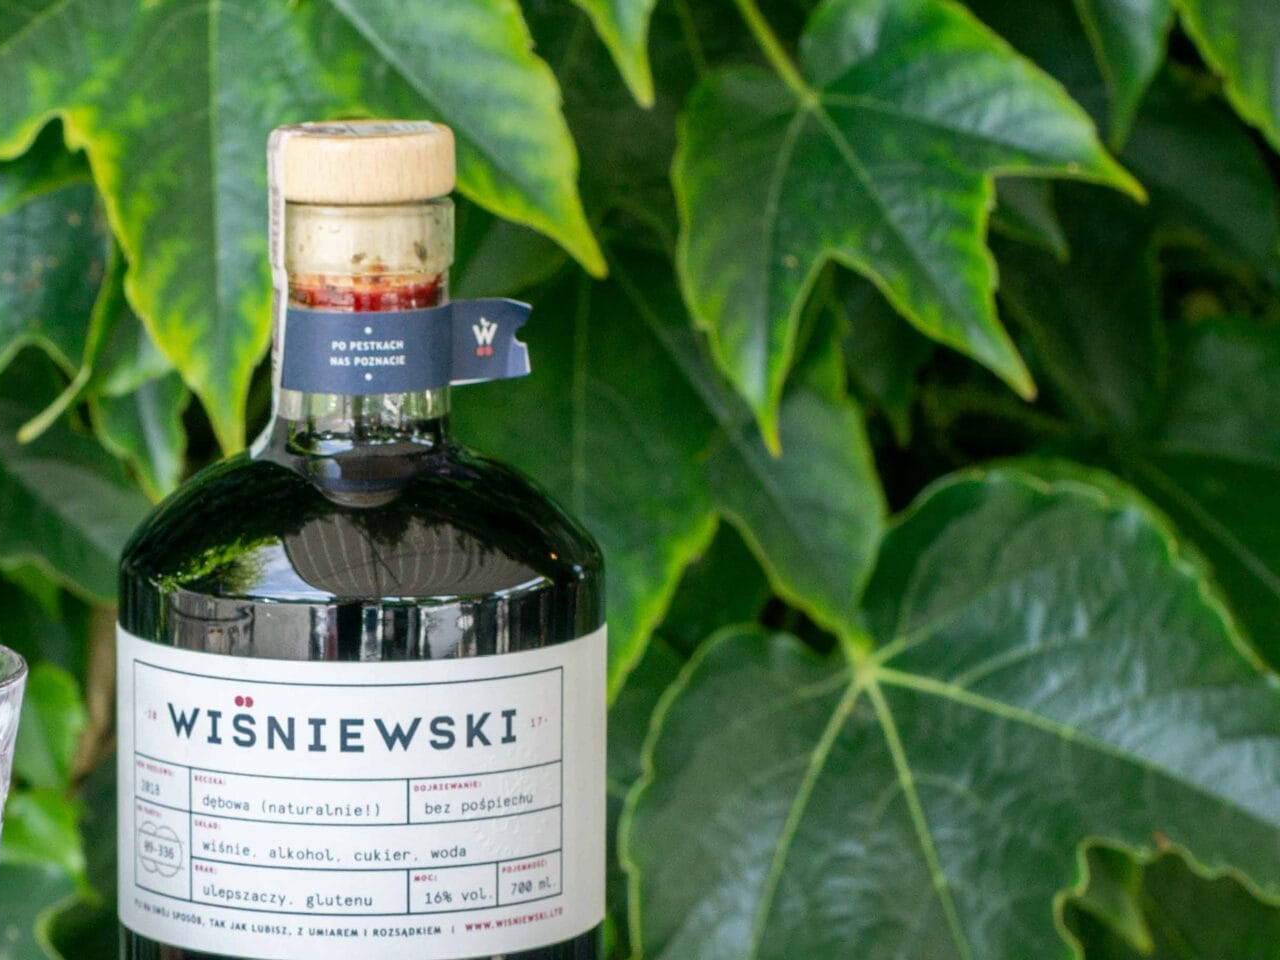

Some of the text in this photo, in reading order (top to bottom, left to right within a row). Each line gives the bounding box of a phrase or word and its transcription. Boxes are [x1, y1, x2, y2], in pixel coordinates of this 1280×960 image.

[331, 340, 404, 351] PO PESTKACH
[329, 355, 406, 366] NAS POZNACIE
[413, 780, 482, 793] DOJRZEWANIE:
[202, 794, 381, 817] dębowa (naturalnie!)
[425, 794, 533, 816] bez pośpiechu
[431, 845, 467, 860] woda
[413, 875, 438, 883] MOC:
[510, 879, 533, 896] 700
[306, 893, 373, 908] glutenu
[425, 887, 494, 905] 16% vol.
[210, 918, 226, 930] TAK
[230, 921, 247, 932] JAK
[251, 924, 292, 937] LUBISZ,
[297, 926, 303, 936] Z
[308, 926, 359, 938] UMIAREM
[372, 926, 442, 939] ROZSĄDKIEM
